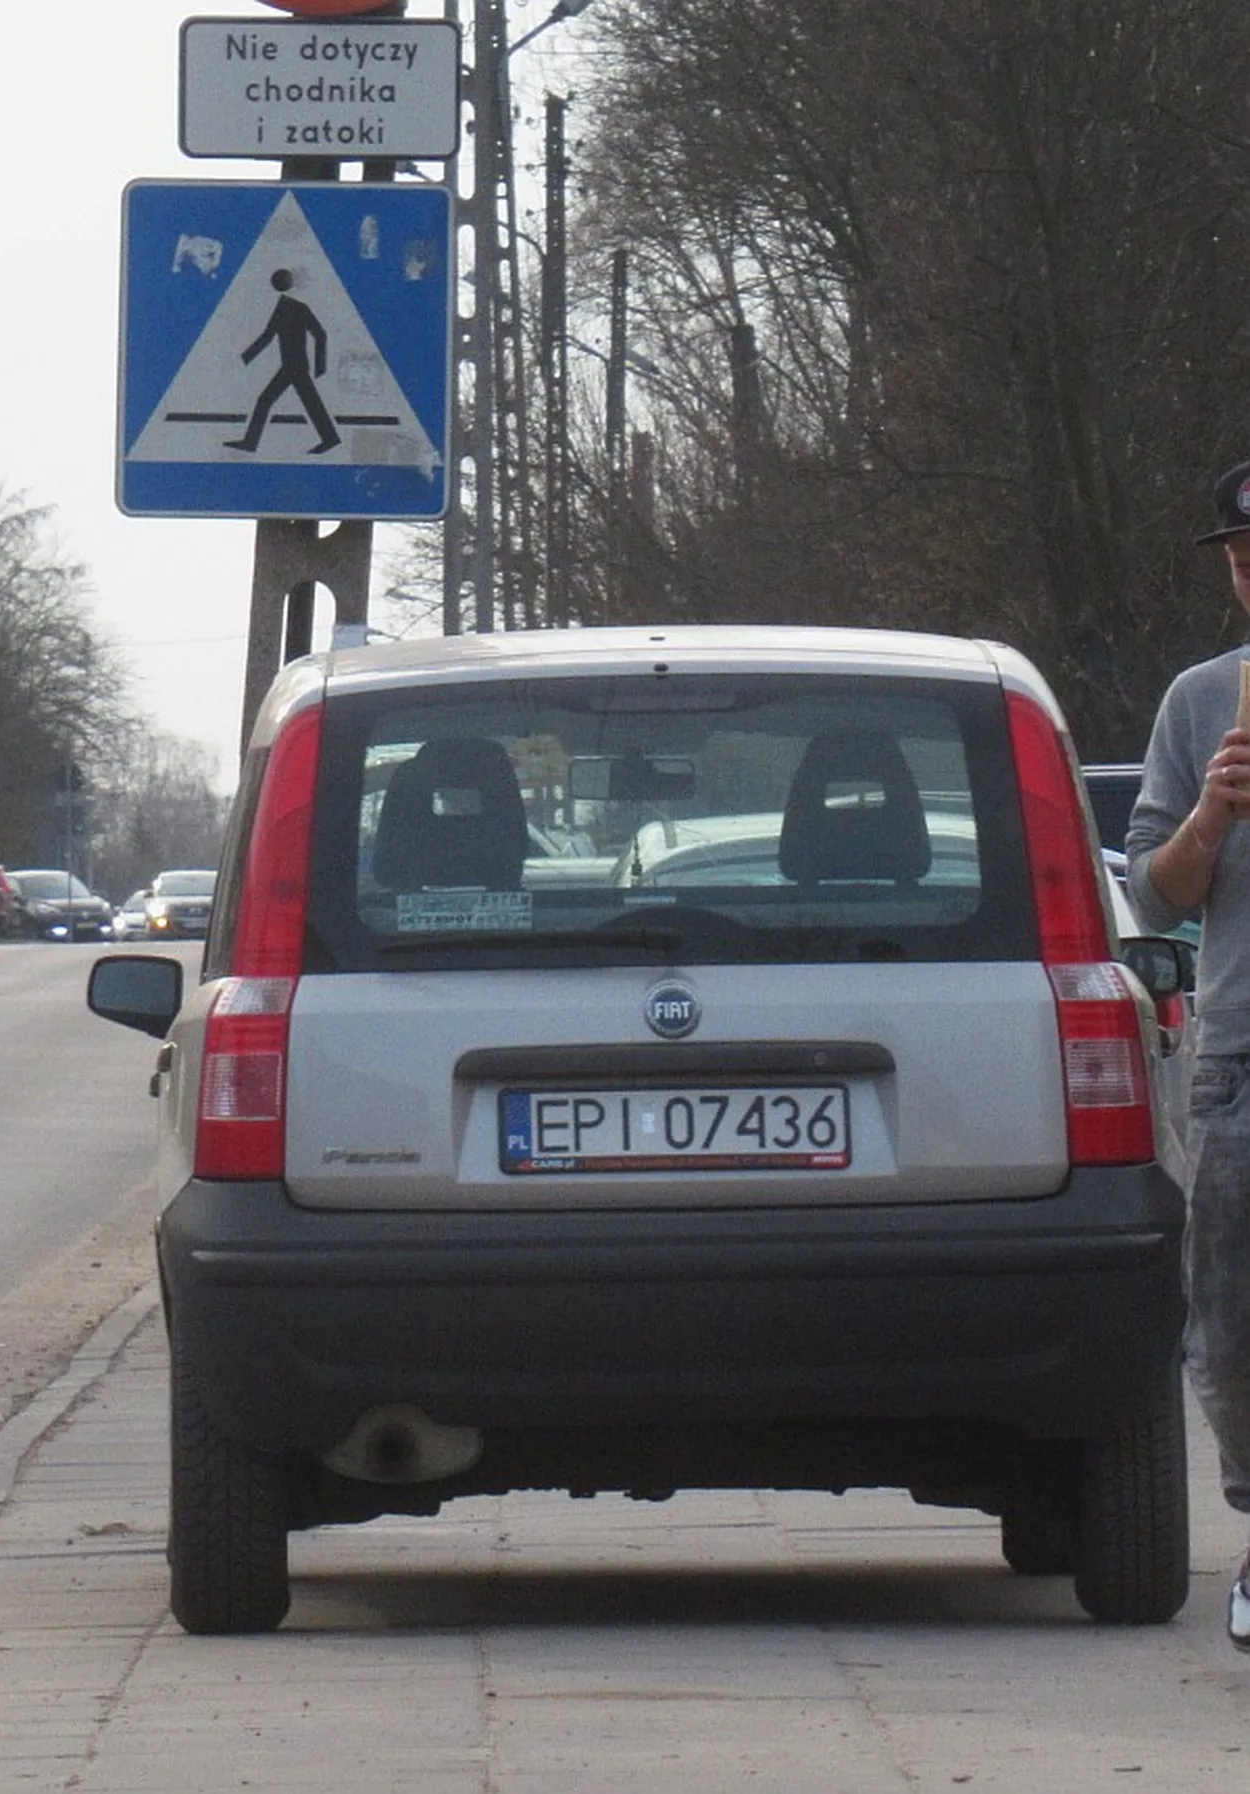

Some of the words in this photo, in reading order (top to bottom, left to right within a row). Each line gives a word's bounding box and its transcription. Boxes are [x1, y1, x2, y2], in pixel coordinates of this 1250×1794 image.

[226, 34, 278, 61] Nie
[299, 34, 418, 69] dotyczy
[245, 76, 396, 103] chodnika
[256, 116, 265, 143] i
[286, 117, 384, 145] zatoki
[654, 1001, 691, 1019] FIAT
[536, 1098, 632, 1153] EPI
[664, 1095, 838, 1149] 07436
[507, 1134, 530, 1150] PL
